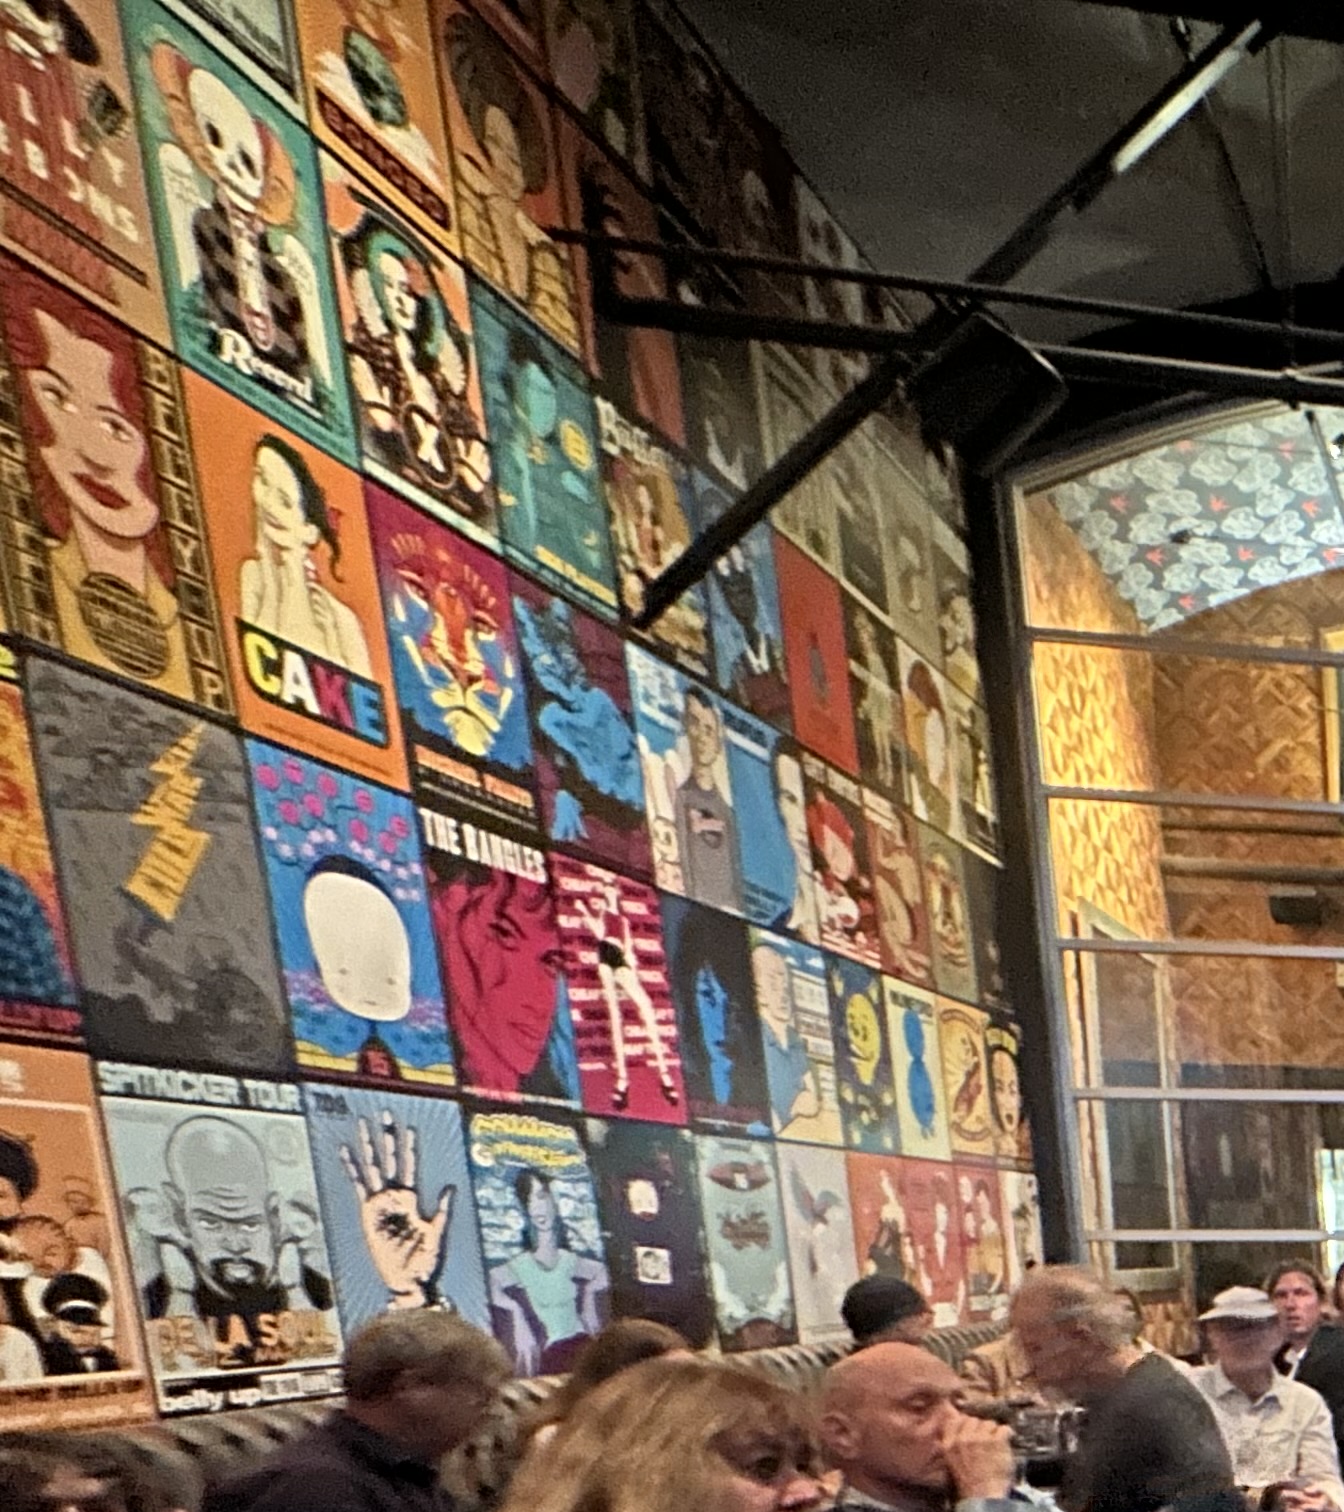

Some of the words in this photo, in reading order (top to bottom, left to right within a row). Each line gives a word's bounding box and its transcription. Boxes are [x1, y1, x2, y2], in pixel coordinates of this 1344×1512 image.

[243, 631, 387, 745] CAKE
[418, 807, 463, 857] THE
[97, 1060, 242, 1106] SPITKICKER
[243, 1078, 302, 1114] TOUR
[209, 1313, 253, 1354] LA
